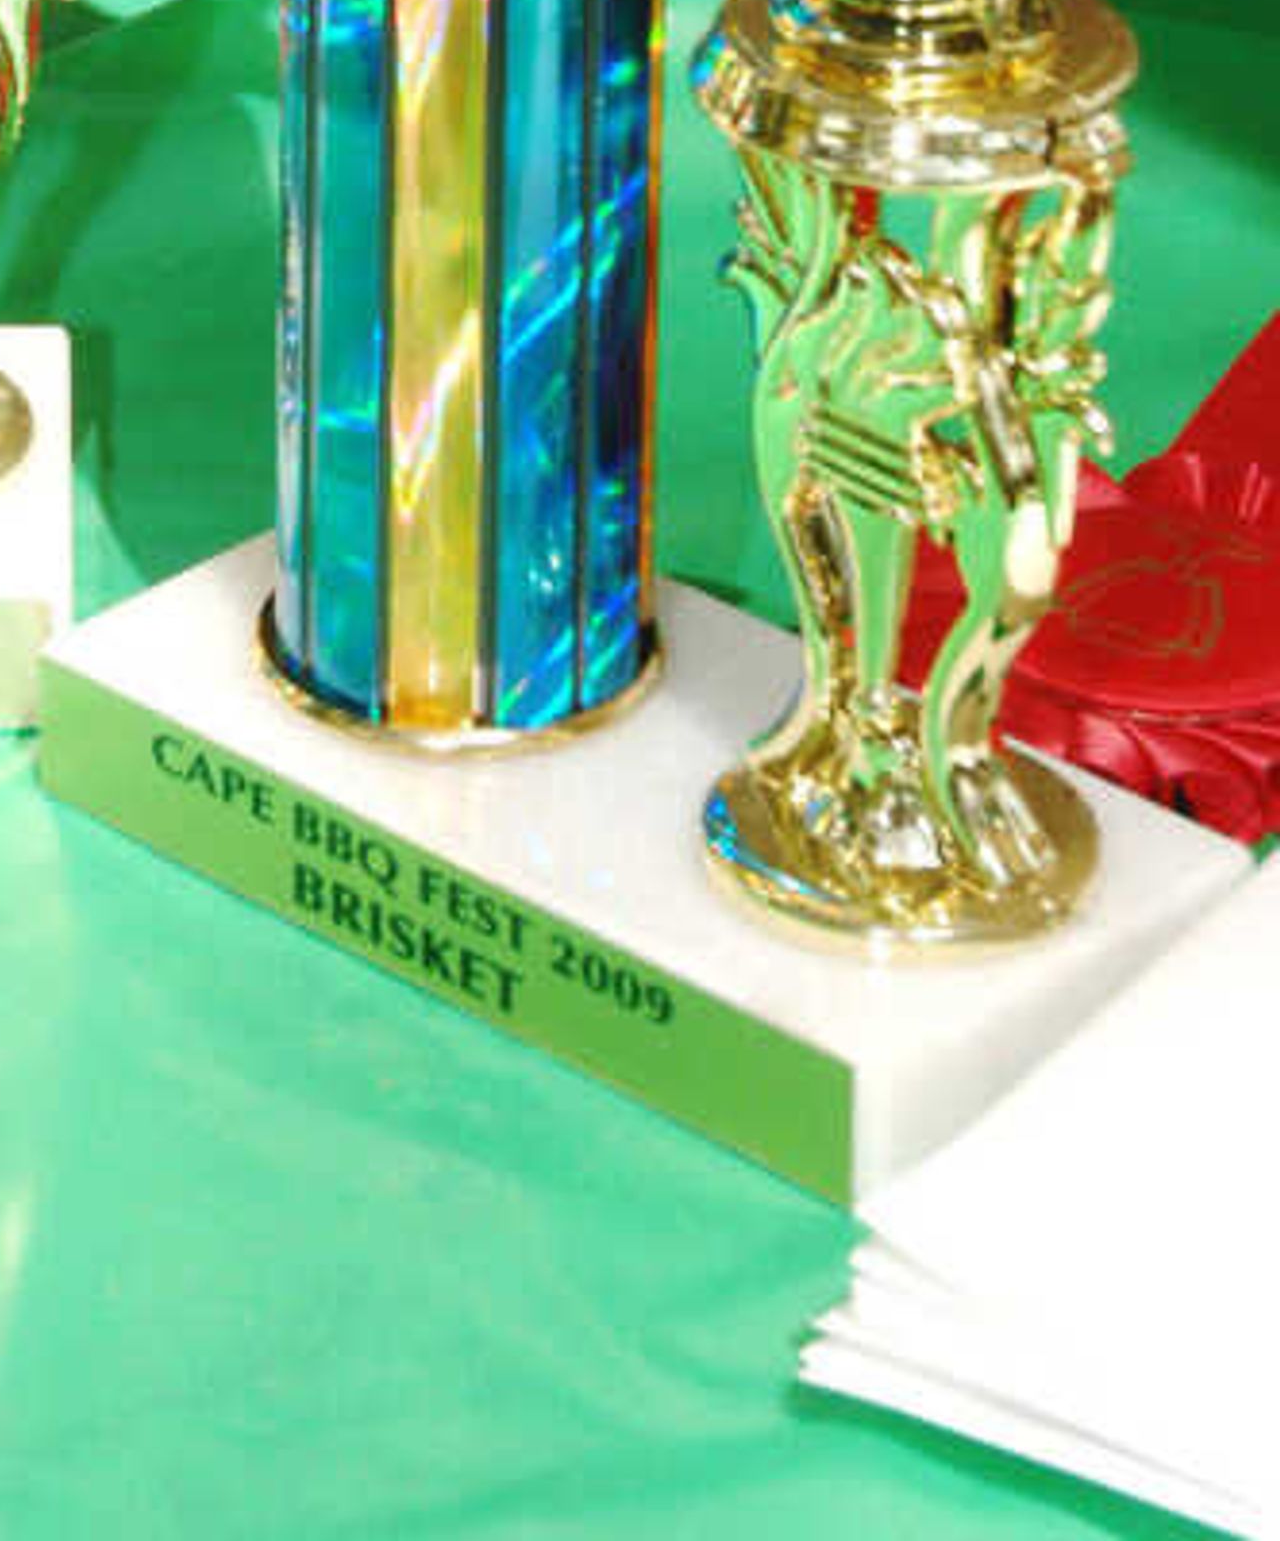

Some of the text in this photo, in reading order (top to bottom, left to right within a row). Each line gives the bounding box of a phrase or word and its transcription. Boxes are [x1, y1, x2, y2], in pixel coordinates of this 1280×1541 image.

[150, 733, 676, 1027] CAPE BBQ FEST 2009
[291, 862, 525, 1014] BRISKET
